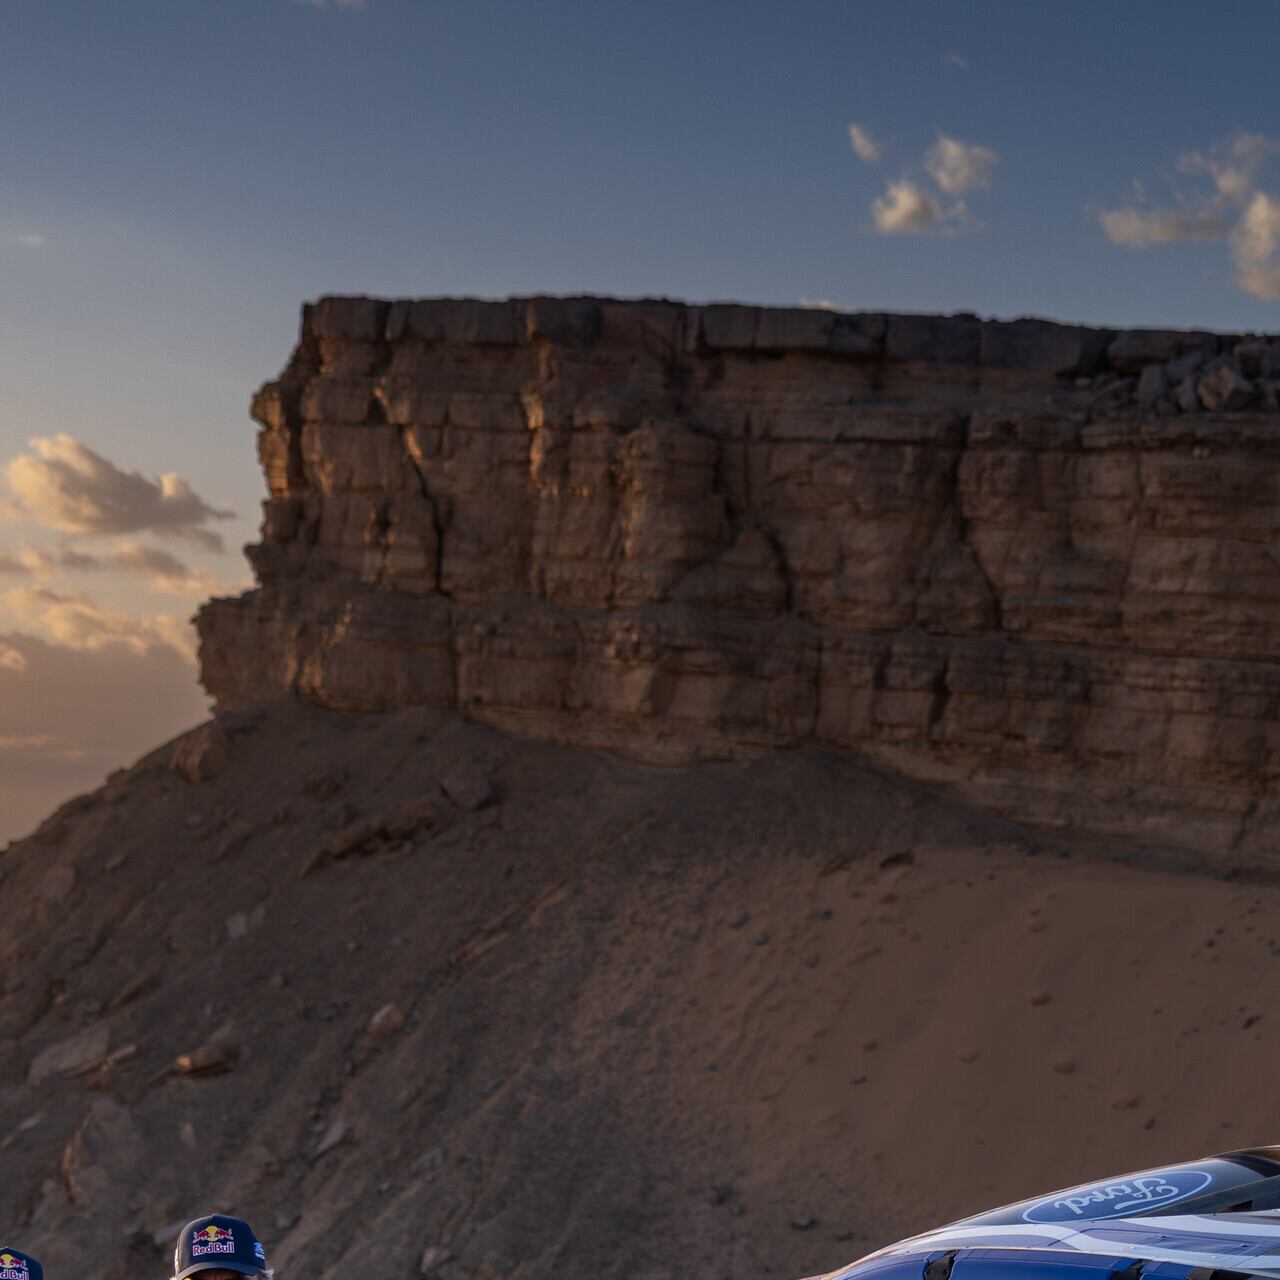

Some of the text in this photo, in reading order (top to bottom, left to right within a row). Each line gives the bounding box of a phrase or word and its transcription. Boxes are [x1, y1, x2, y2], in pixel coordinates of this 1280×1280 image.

[1054, 1177, 1180, 1215] Ford
[193, 1241, 235, 1256] Red Bull
